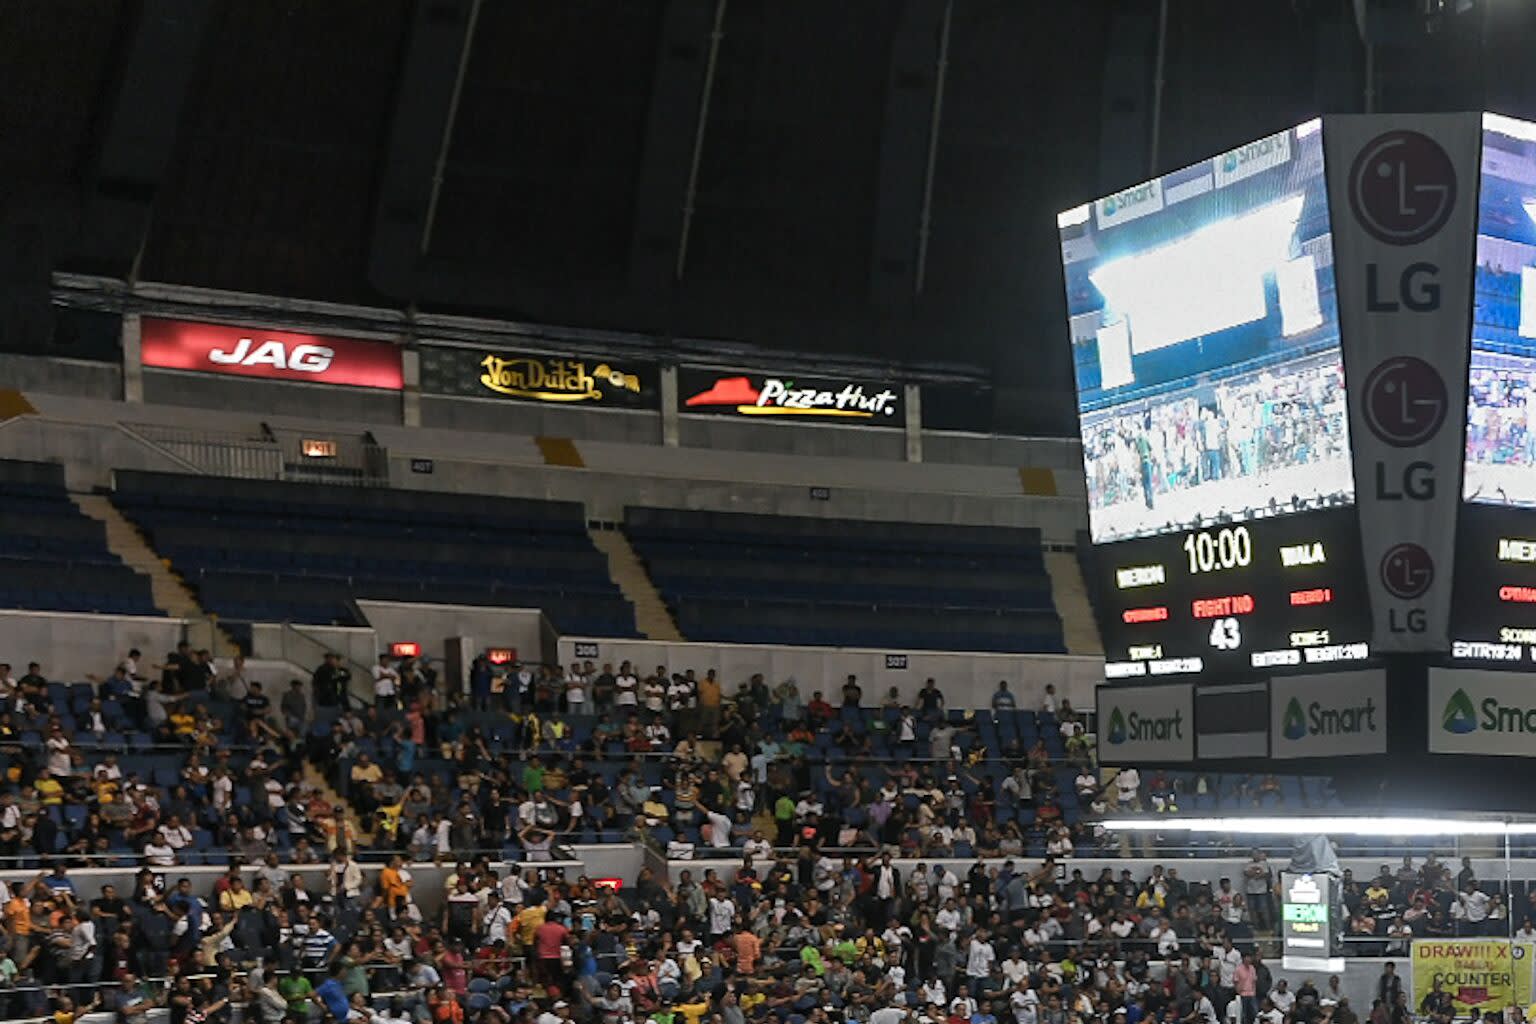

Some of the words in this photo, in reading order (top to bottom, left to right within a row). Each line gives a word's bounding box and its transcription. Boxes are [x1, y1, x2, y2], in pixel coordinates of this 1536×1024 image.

[1365, 262, 1441, 313] LG
[208, 338, 335, 373] JAG
[756, 379, 834, 409] Pizza
[1375, 461, 1435, 501] LG
[1184, 526, 1251, 573] 10:00
[1192, 597, 1231, 619] FIGHT
[1389, 608, 1427, 633] LG
[1209, 617, 1241, 650] 43
[1127, 708, 1184, 741] Smart
[1308, 697, 1377, 736] Smart
[1433, 972, 1512, 987] COUNTER
